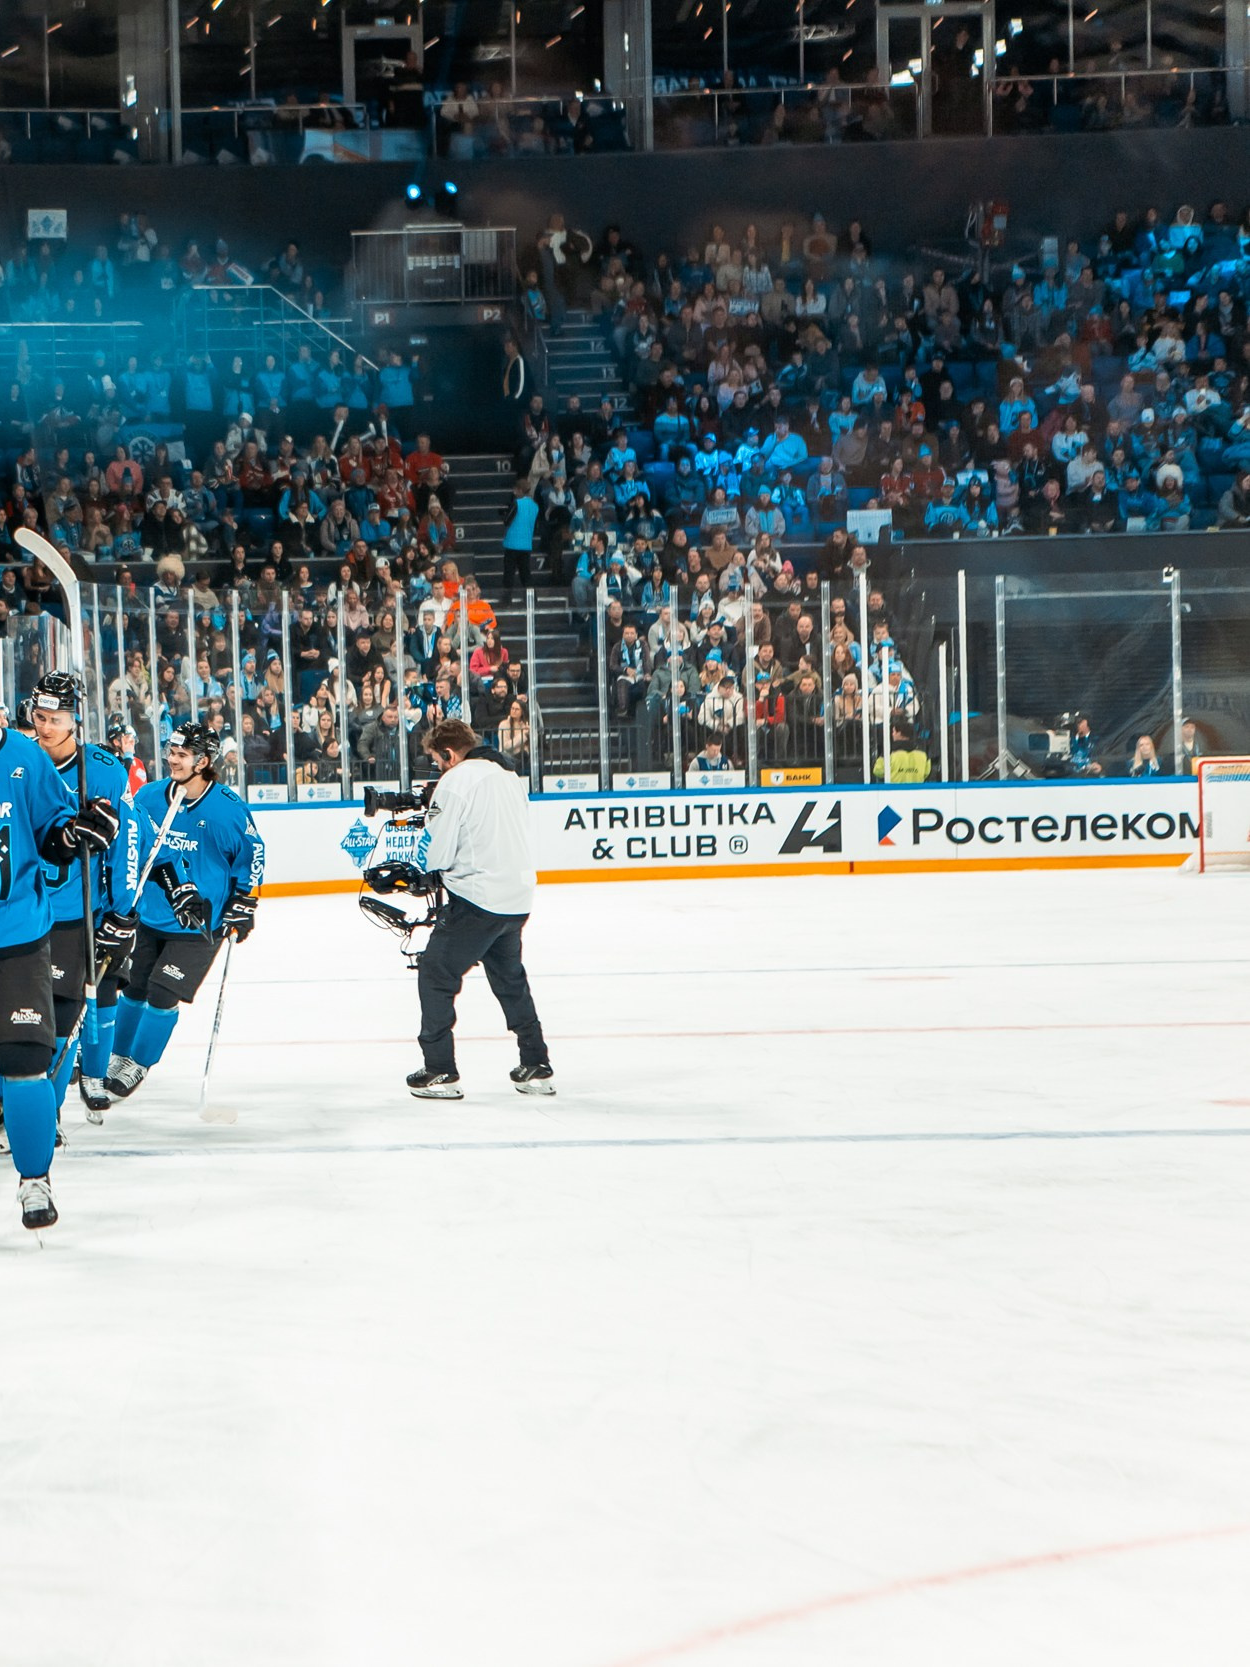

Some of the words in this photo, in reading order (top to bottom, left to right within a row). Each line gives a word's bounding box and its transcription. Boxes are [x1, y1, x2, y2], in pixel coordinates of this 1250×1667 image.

[374, 312, 390, 324] P1
[483, 309, 501, 321] P2
[614, 397, 628, 409] 12
[496, 460, 511, 473] 10
[455, 527, 465, 540] 8
[536, 557, 546, 570] 7
[785, 774, 812, 782] БАНК
[564, 801, 777, 831] ATRIBUTIKA
[912, 807, 1200, 846] Ростелеком
[591, 838, 615, 860] &
[626, 835, 718, 859] CLUB
